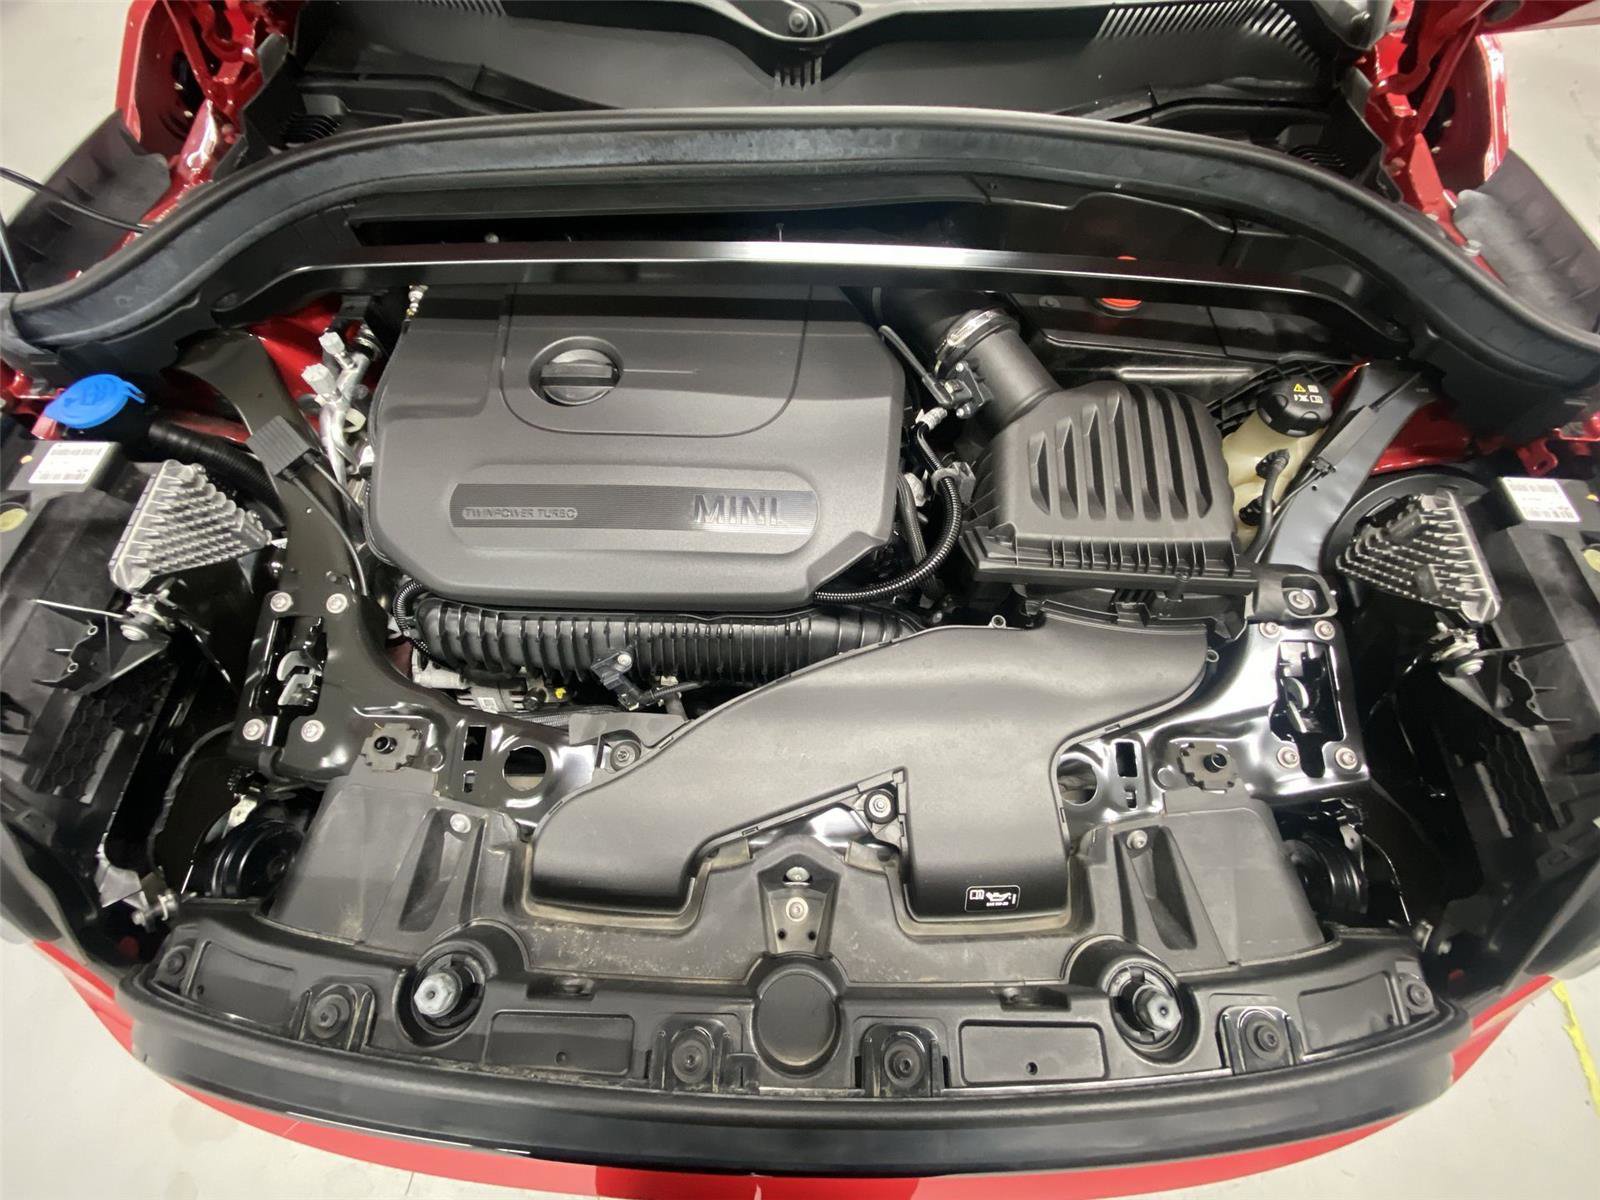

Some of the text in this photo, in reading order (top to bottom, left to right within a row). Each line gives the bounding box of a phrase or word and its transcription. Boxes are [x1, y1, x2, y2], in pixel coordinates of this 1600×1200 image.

[465, 507, 576, 519] TWINPOWER TURBO
[694, 494, 778, 525] MINI
